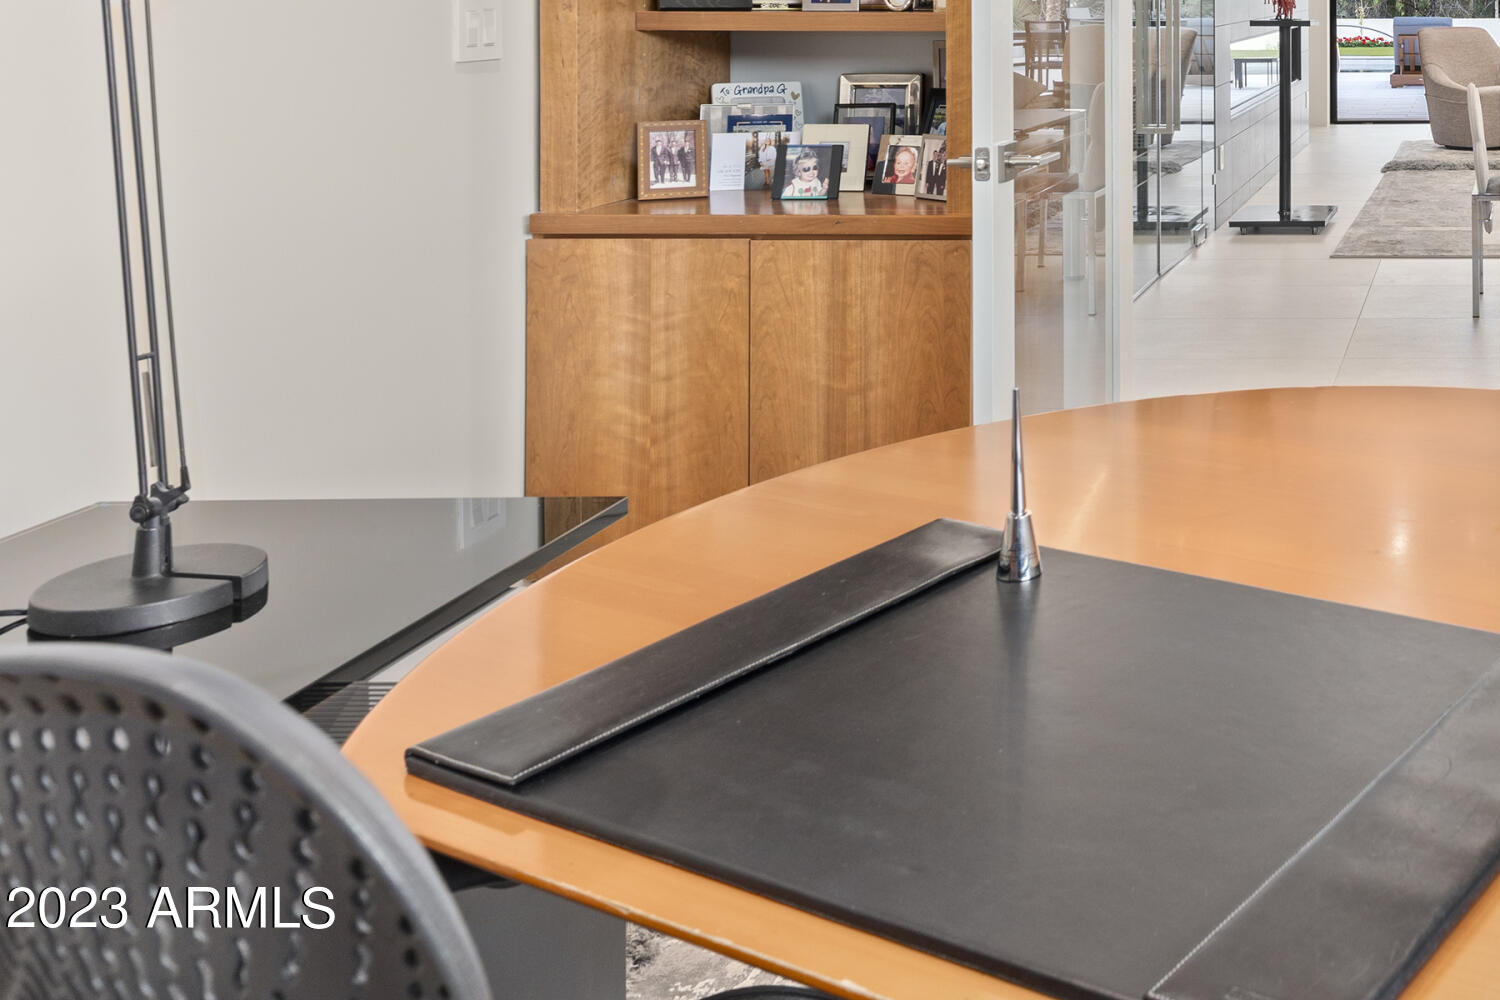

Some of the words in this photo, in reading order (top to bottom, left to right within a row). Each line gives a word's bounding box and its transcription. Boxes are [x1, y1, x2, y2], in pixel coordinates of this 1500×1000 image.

[720, 87, 730, 96] To
[733, 83, 775, 96] Grandpa
[776, 83, 788, 94] G
